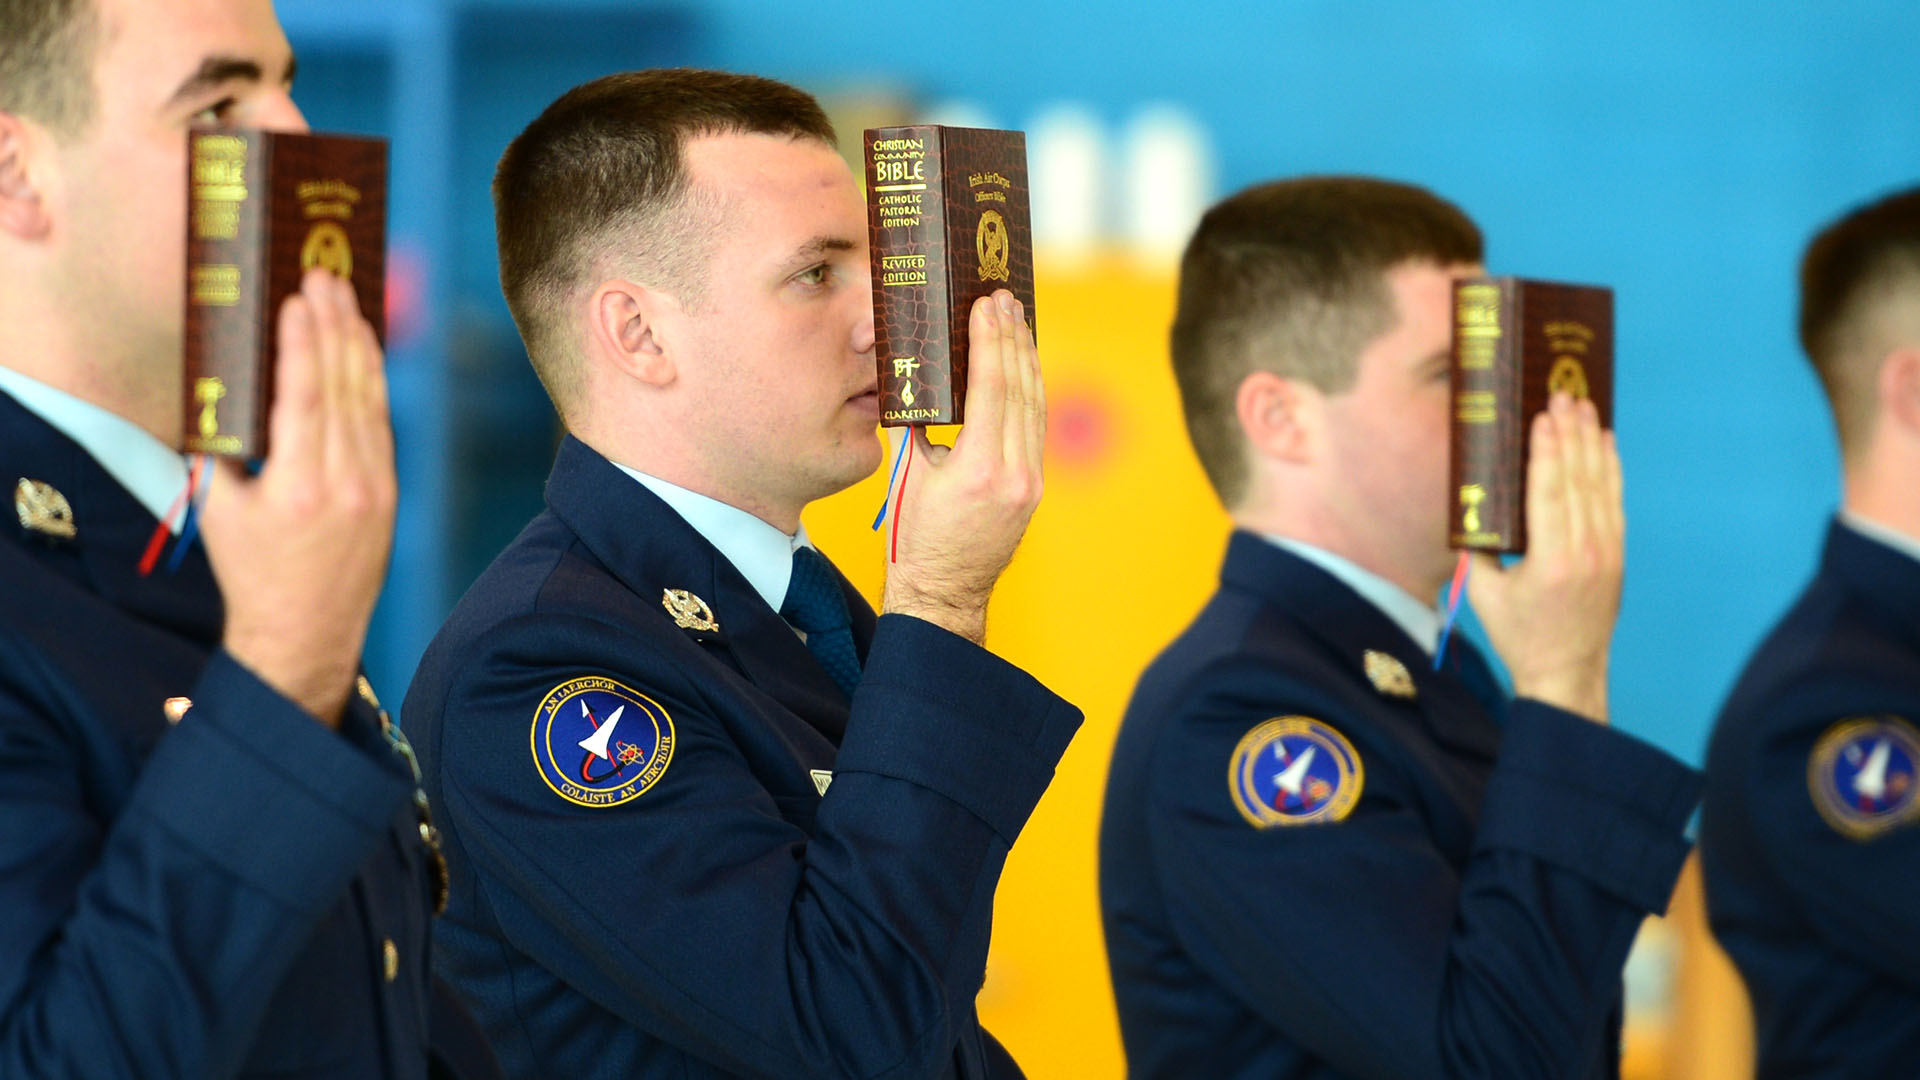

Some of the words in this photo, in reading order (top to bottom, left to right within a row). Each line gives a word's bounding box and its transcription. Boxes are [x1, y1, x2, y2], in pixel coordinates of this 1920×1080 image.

[873, 138, 924, 152] CHRISTIAN
[873, 151, 926, 161] COMMUNITY
[875, 160, 925, 182] BIBLE
[878, 194, 922, 205] CATHOLIC
[879, 205, 922, 217] PASTORAL
[882, 217, 920, 228] EDITION
[882, 258, 926, 270] REVISED
[883, 271, 927, 283] EDITION
[884, 408, 940, 420] CLARETIAN
[545, 696, 559, 714] AN
[621, 784, 636, 799] AN
